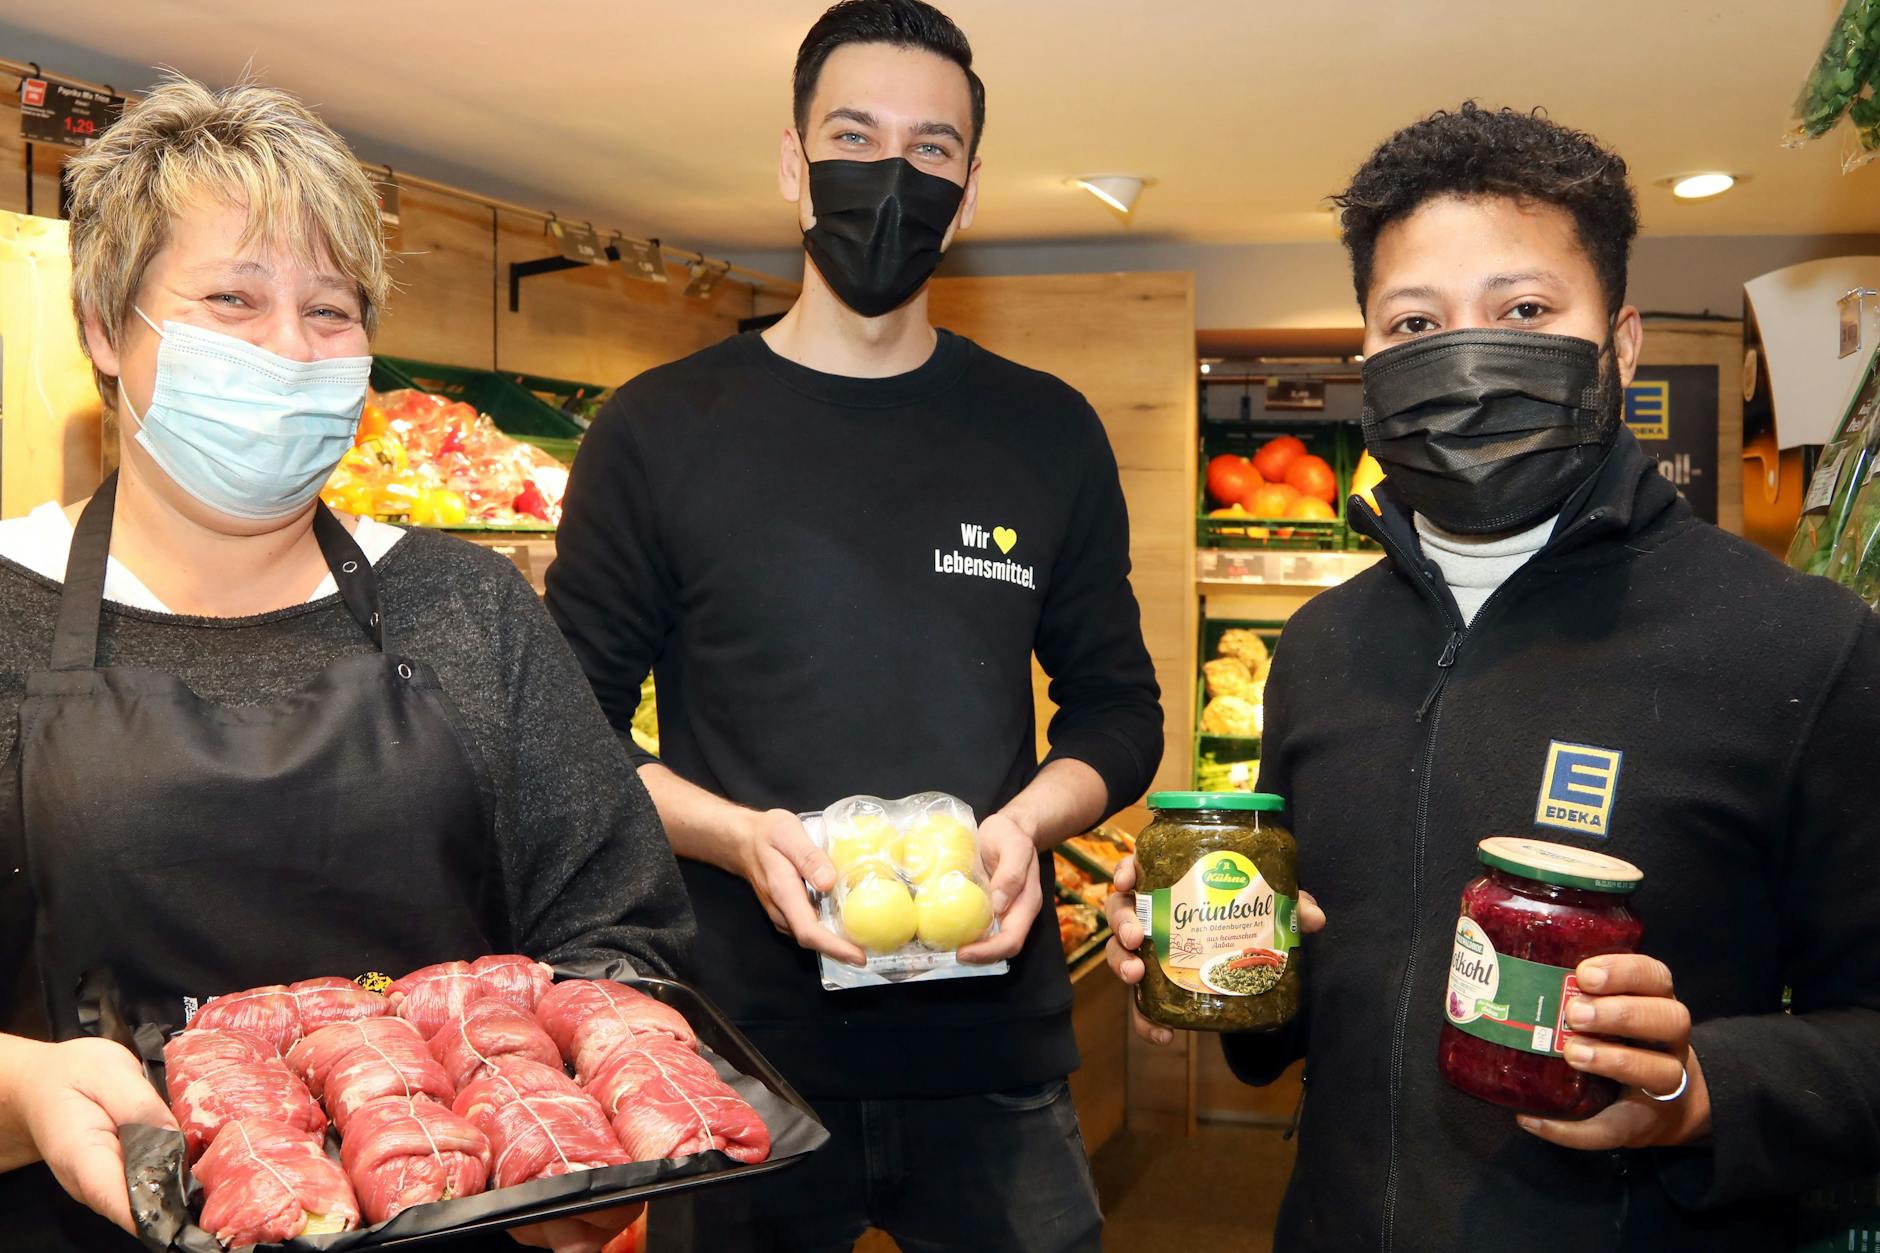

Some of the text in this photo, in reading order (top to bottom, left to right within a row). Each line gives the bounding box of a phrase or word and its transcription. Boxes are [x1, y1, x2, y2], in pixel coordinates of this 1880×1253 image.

[64, 116, 94, 135] 1,29
[1632, 427, 1664, 435] DEKA
[1658, 453, 1702, 484] oll-
[960, 522, 990, 549] Wir
[934, 548, 1036, 590] Lebensmittel.
[1548, 750, 1611, 808] E
[1545, 805, 1602, 827] EDEKA
[1205, 872, 1247, 884] Kühne
[1174, 894, 1273, 930] Grünkohl
[1190, 925, 1208, 933] nach
[1209, 922, 1253, 933] Oldenburger
[1211, 941, 1235, 949] Anbau
[1452, 950, 1493, 985] otkohl
